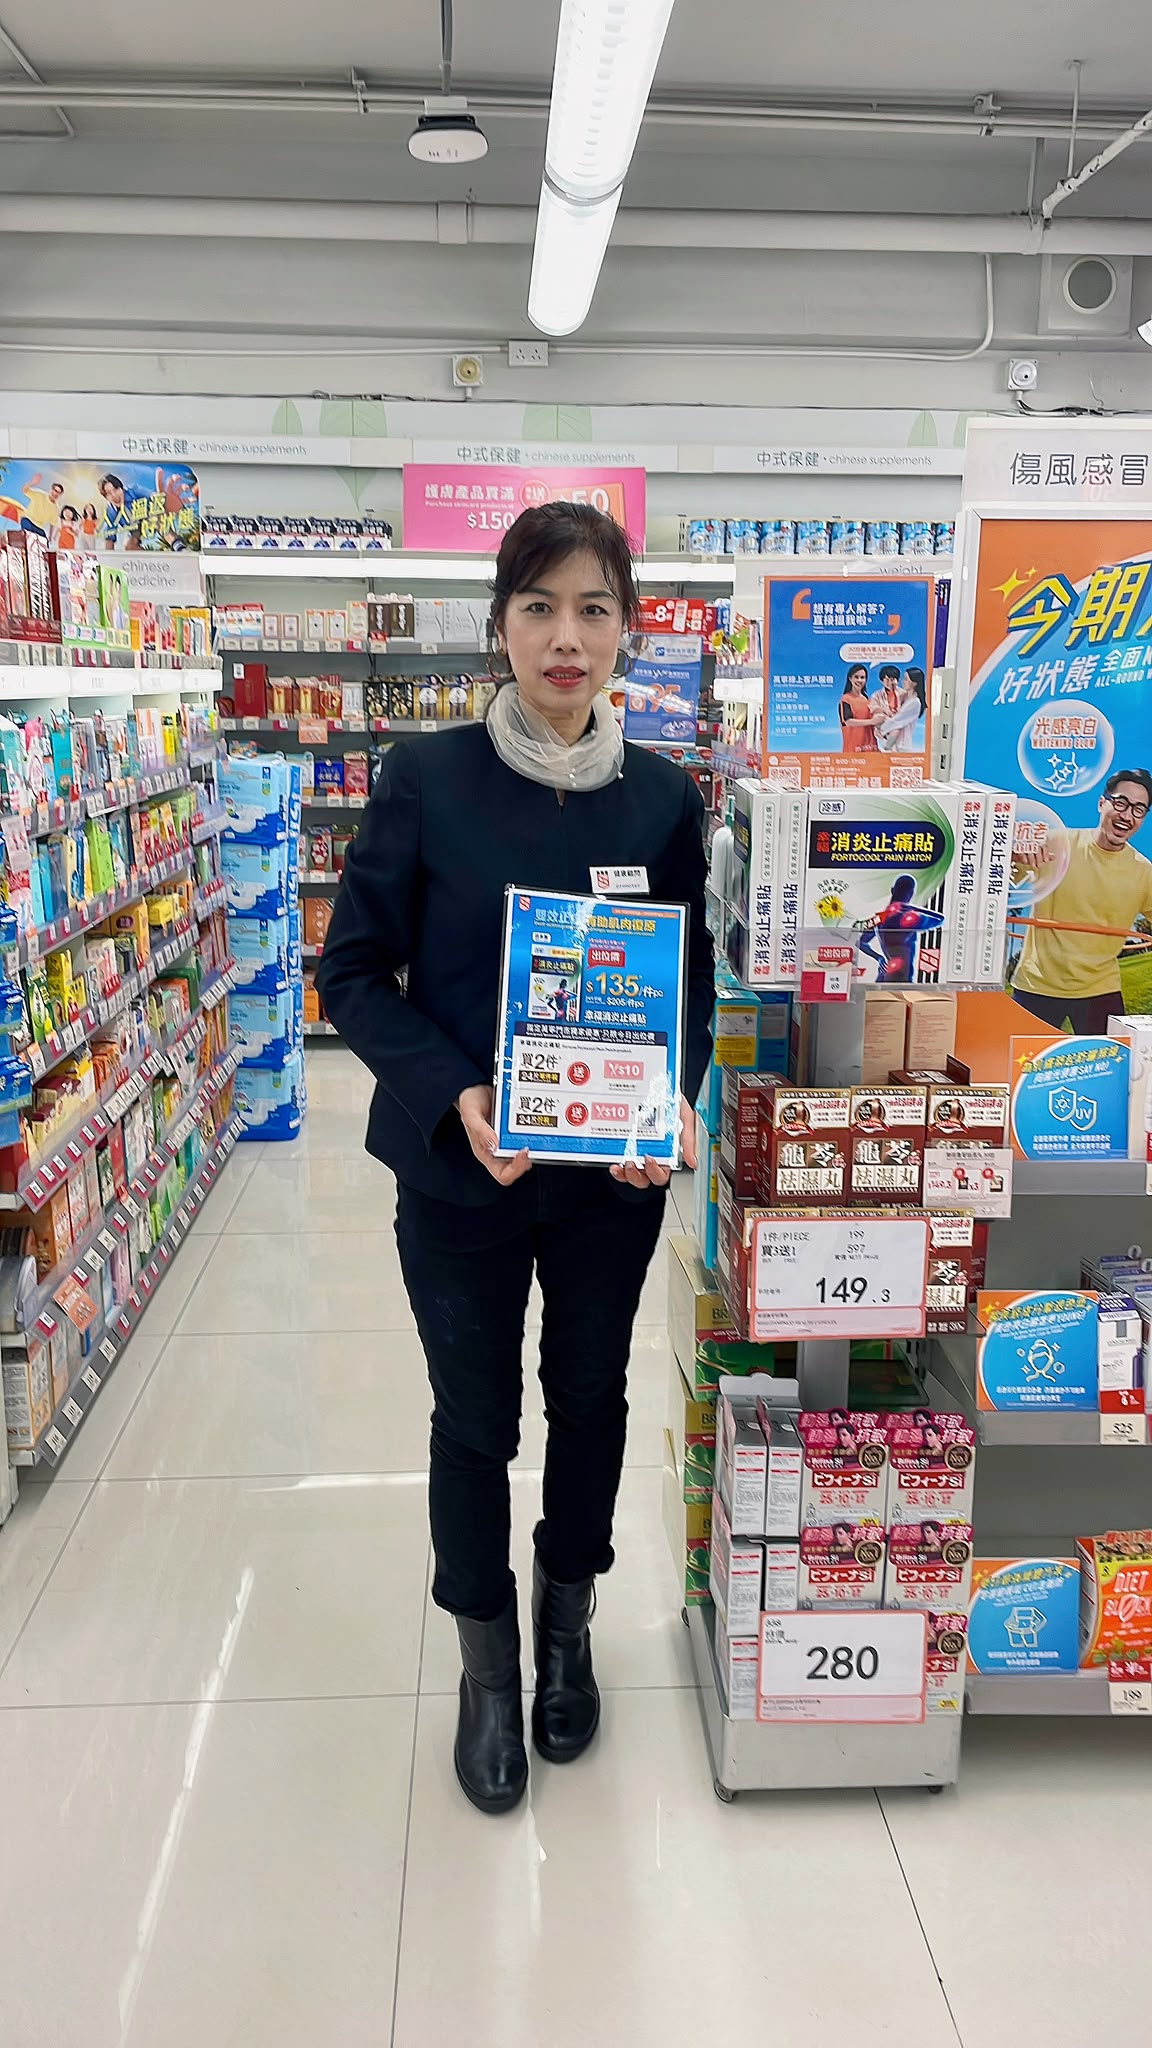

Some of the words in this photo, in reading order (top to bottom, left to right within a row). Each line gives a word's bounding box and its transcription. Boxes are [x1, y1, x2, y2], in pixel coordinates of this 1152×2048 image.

[199, 441, 238, 454] chinese
[531, 451, 571, 463] chinese
[829, 453, 868, 465] chinese
[1009, 452, 1149, 486] 傷風感冒
[467, 511, 516, 530] $150
[121, 559, 171, 573] chinese
[1007, 562, 1152, 656] 今期
[993, 654, 1101, 706] 好狀態
[1035, 717, 1098, 737] 光感亮白
[822, 802, 842, 813] 冷感
[831, 831, 936, 853] 消炎止痛貼
[884, 854, 904, 862] PAIN
[905, 854, 933, 862] PATCH
[534, 908, 577, 925] 雙效止
[1075, 1108, 1093, 1120] UV
[761, 1244, 797, 1257] 買3送1
[813, 1472, 878, 1487] ビフィーナSi
[900, 1472, 964, 1488] ビフィーナSi
[810, 1567, 874, 1582] ビフィーナSi
[898, 1567, 961, 1582] ビフィーナSi
[1113, 1570, 1150, 1593] DIET
[806, 1645, 880, 1680] 280
